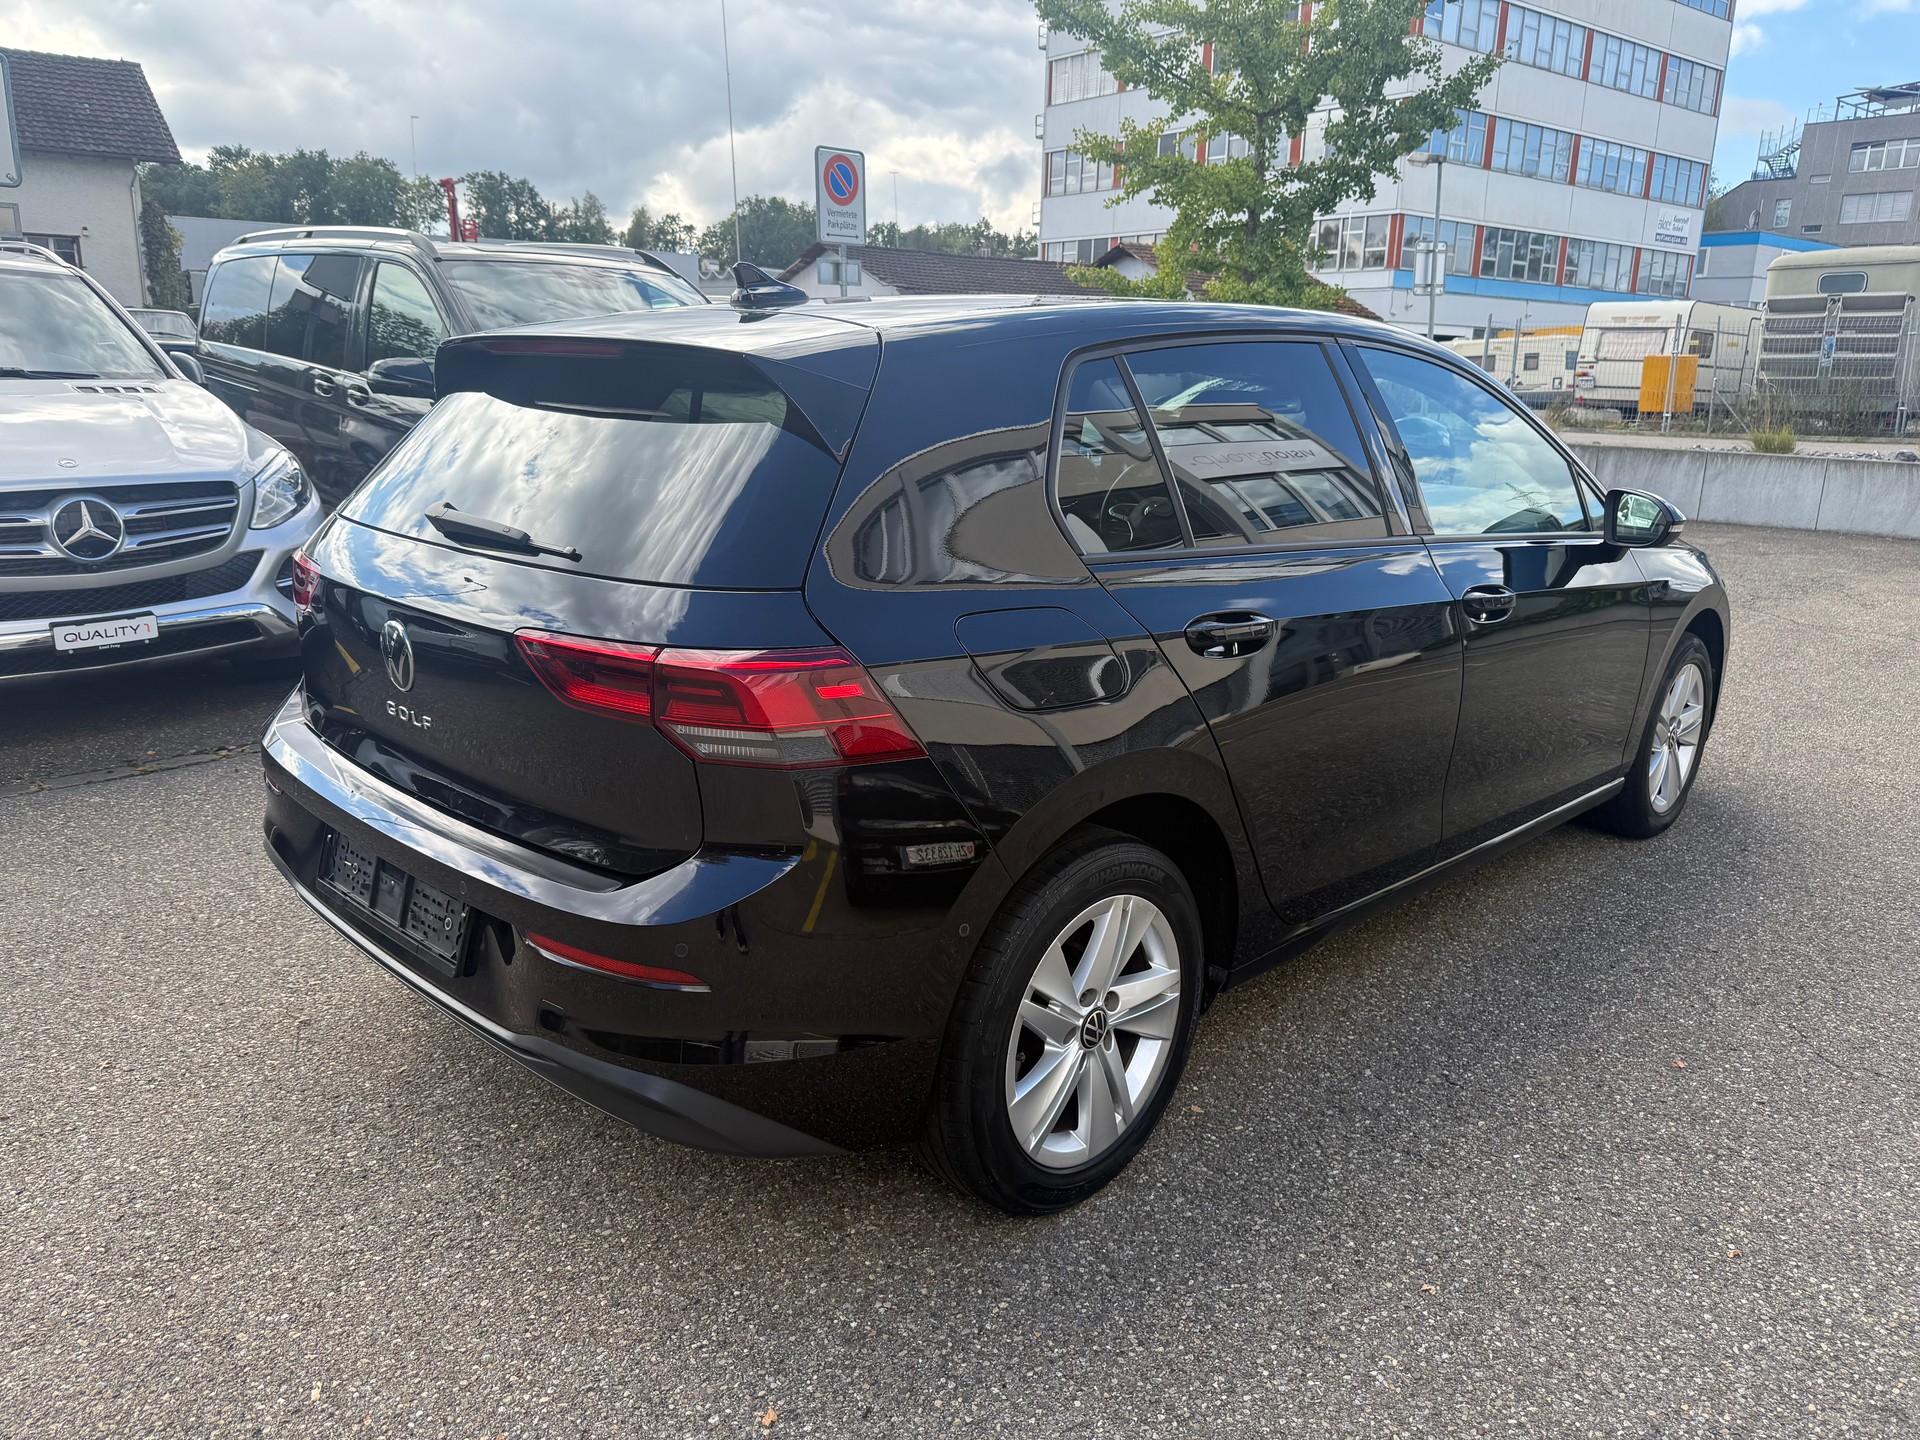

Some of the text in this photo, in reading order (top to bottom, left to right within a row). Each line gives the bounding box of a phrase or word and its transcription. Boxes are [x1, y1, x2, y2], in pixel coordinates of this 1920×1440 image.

[826, 208, 858, 220] Vermietete
[827, 219, 858, 231] Parkplätze
[63, 623, 151, 643] QUALITY 1
[386, 700, 432, 730] GOLF
